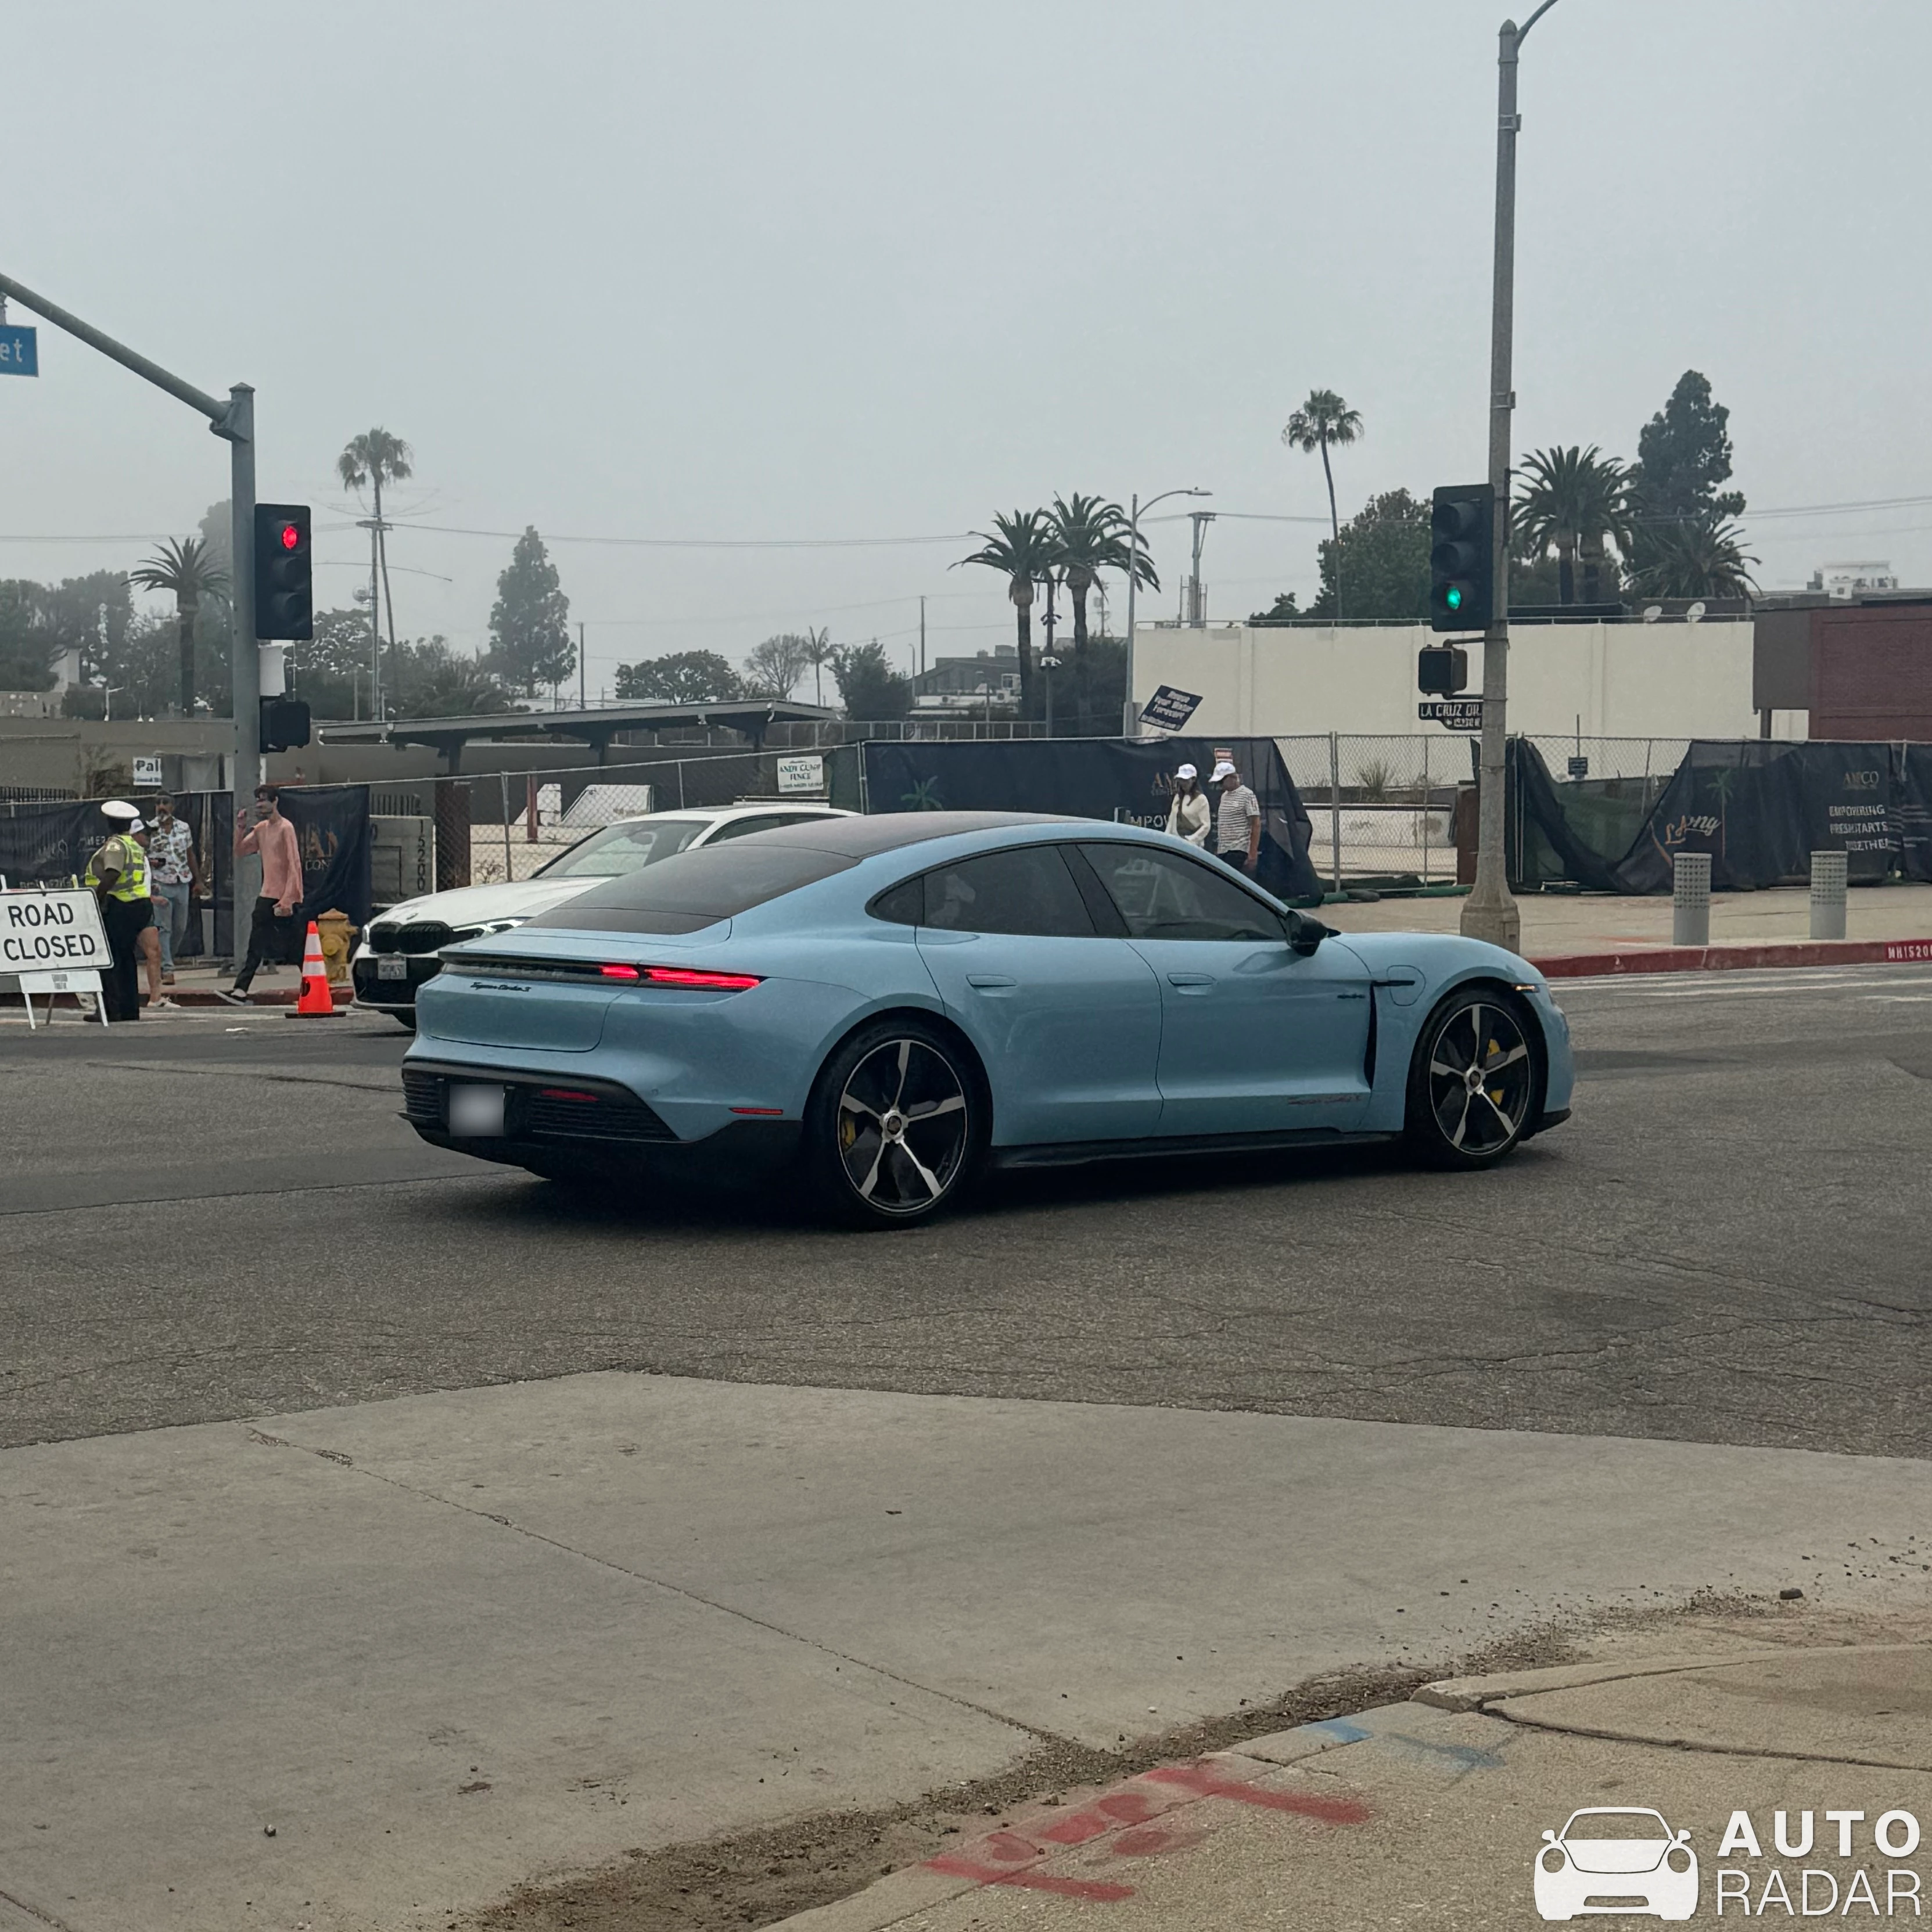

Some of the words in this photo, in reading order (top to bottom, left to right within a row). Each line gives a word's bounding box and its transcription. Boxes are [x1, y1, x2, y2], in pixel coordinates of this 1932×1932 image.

[1421, 704, 1432, 717] LA
[1436, 704, 1461, 717] CRUZ
[417, 819, 426, 892] 15200
[8, 903, 74, 928] ROAD
[3, 934, 95, 961] CLOSED
